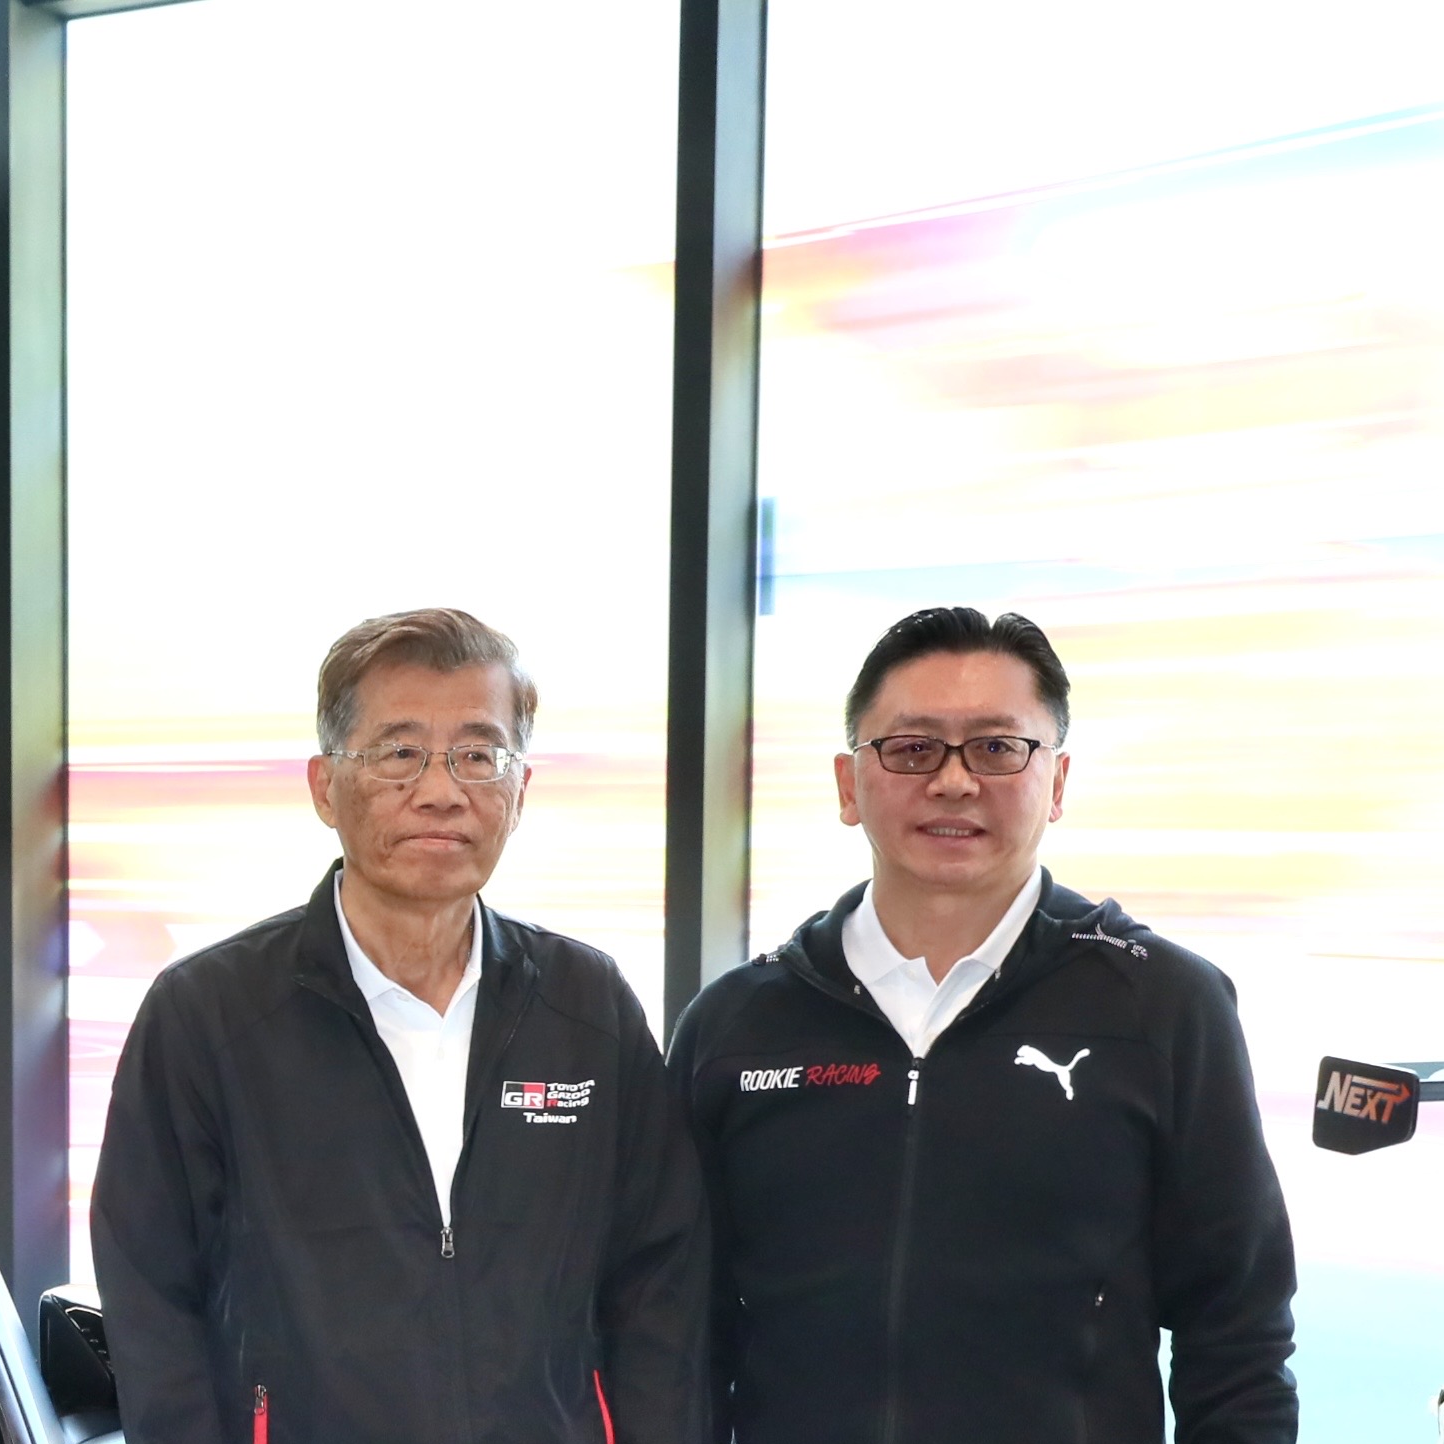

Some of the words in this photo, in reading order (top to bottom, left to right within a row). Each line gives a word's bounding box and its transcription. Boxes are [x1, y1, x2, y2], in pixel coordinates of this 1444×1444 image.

[740, 1066, 803, 1091] ROOKIE
[805, 1063, 881, 1086] RACING
[547, 1079, 595, 1091] TOYOTA
[504, 1091, 543, 1107] GR
[547, 1088, 591, 1100] GAZOO
[546, 1096, 589, 1108] Racing
[523, 1112, 577, 1124] Taiwan
